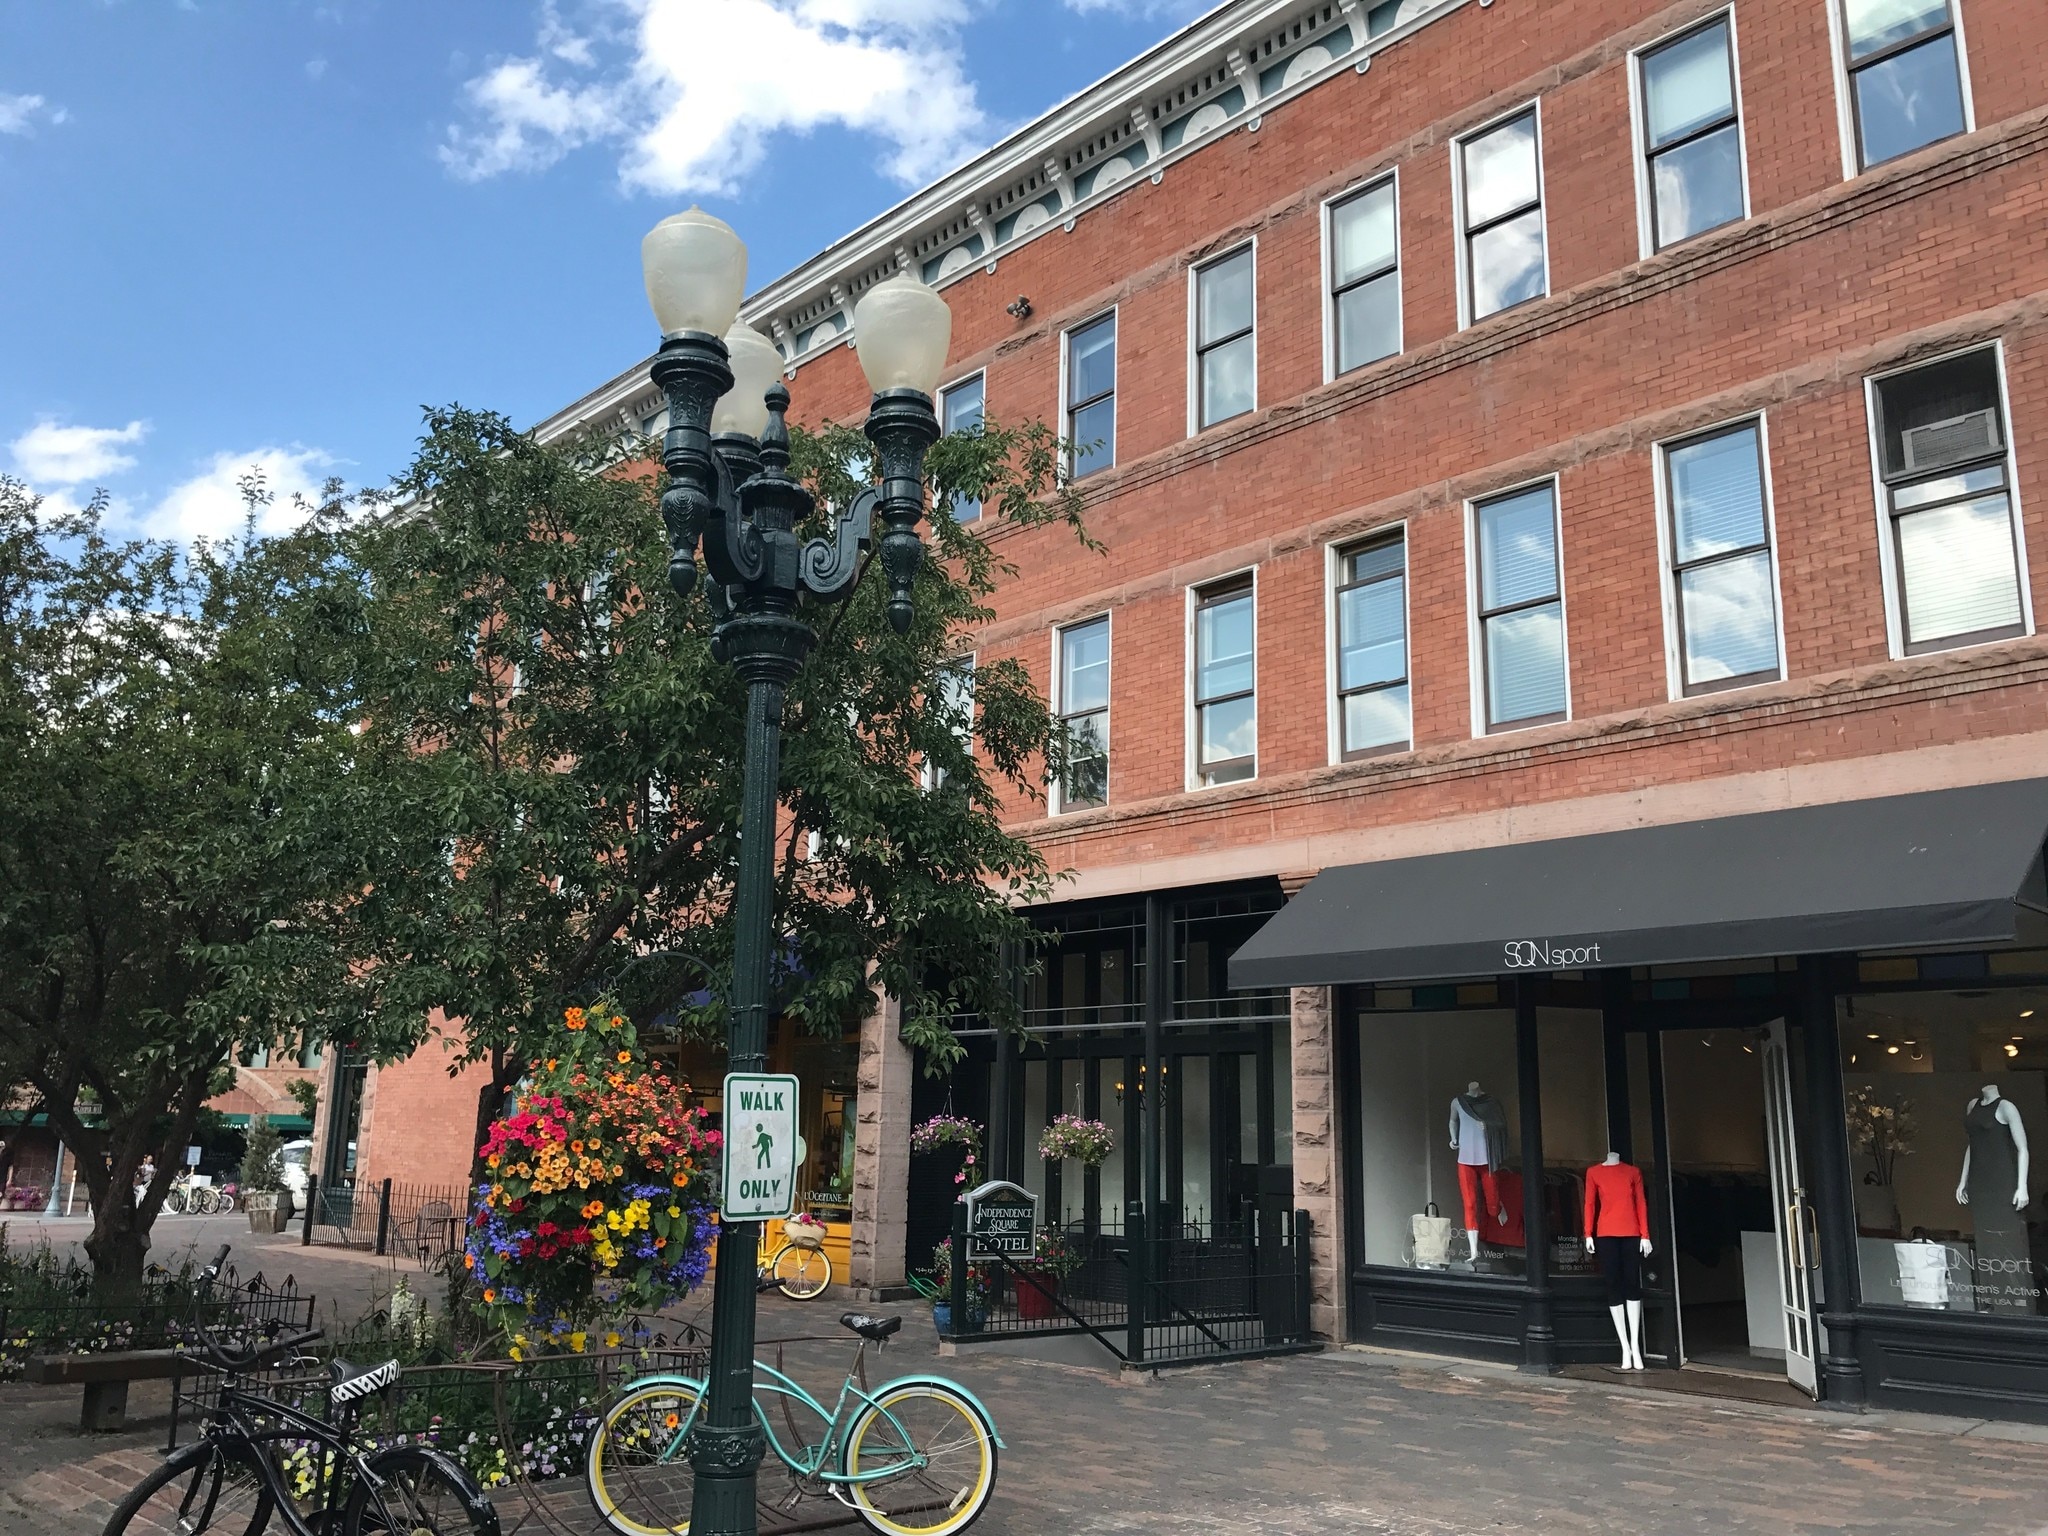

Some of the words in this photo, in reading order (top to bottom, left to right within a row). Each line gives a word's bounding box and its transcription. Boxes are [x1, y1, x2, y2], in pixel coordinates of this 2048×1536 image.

[740, 1091, 784, 1111] WALK
[739, 1180, 781, 1199] ONLY
[974, 1203, 1033, 1224] INDEPENDENCE
[988, 1218, 1019, 1236] SQUARE
[1977, 1257, 2034, 1276] sport
[1948, 1281, 2000, 1295] Women's
[2004, 1285, 2041, 1297] Active
[1976, 1297, 1992, 1305] THE
